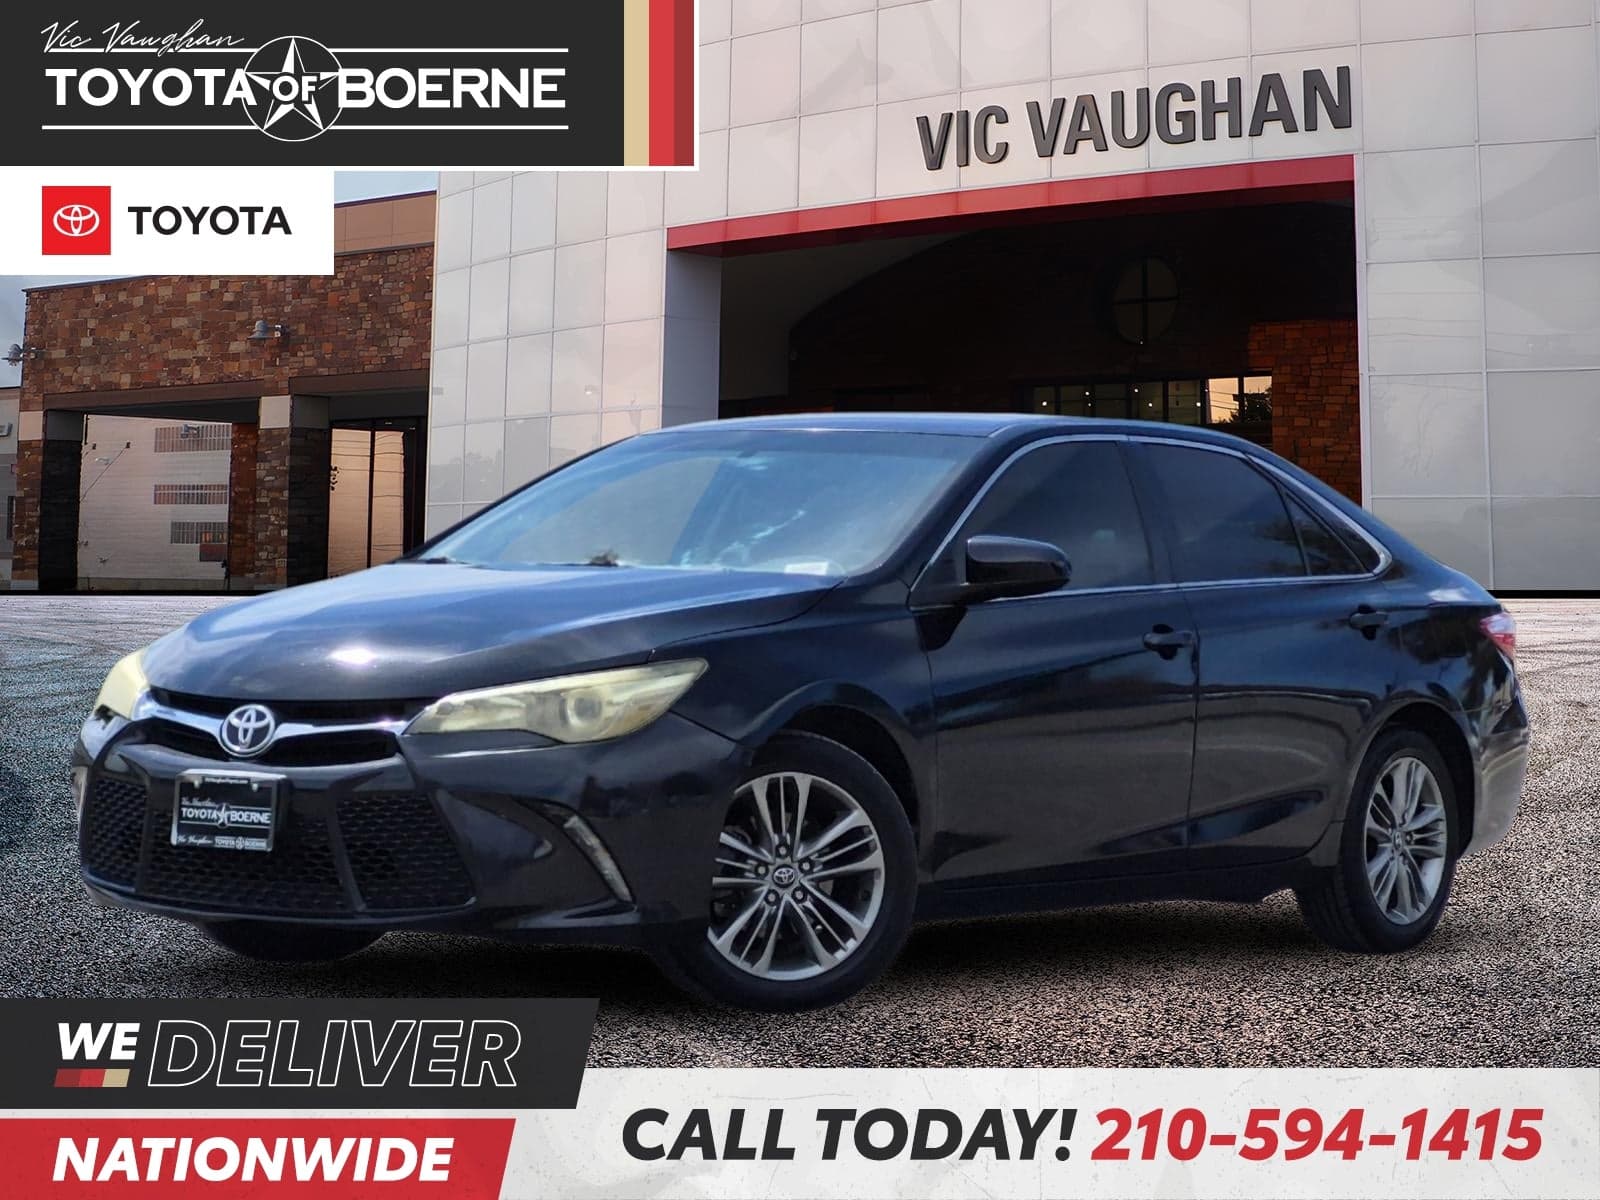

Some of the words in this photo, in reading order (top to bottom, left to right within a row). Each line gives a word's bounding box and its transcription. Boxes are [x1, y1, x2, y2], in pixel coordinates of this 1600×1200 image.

[916, 104, 1009, 171] VIC
[1025, 66, 1352, 158] VAUGHAN
[181, 808, 217, 820] TOYOTA
[231, 811, 271, 823] BOERNE
